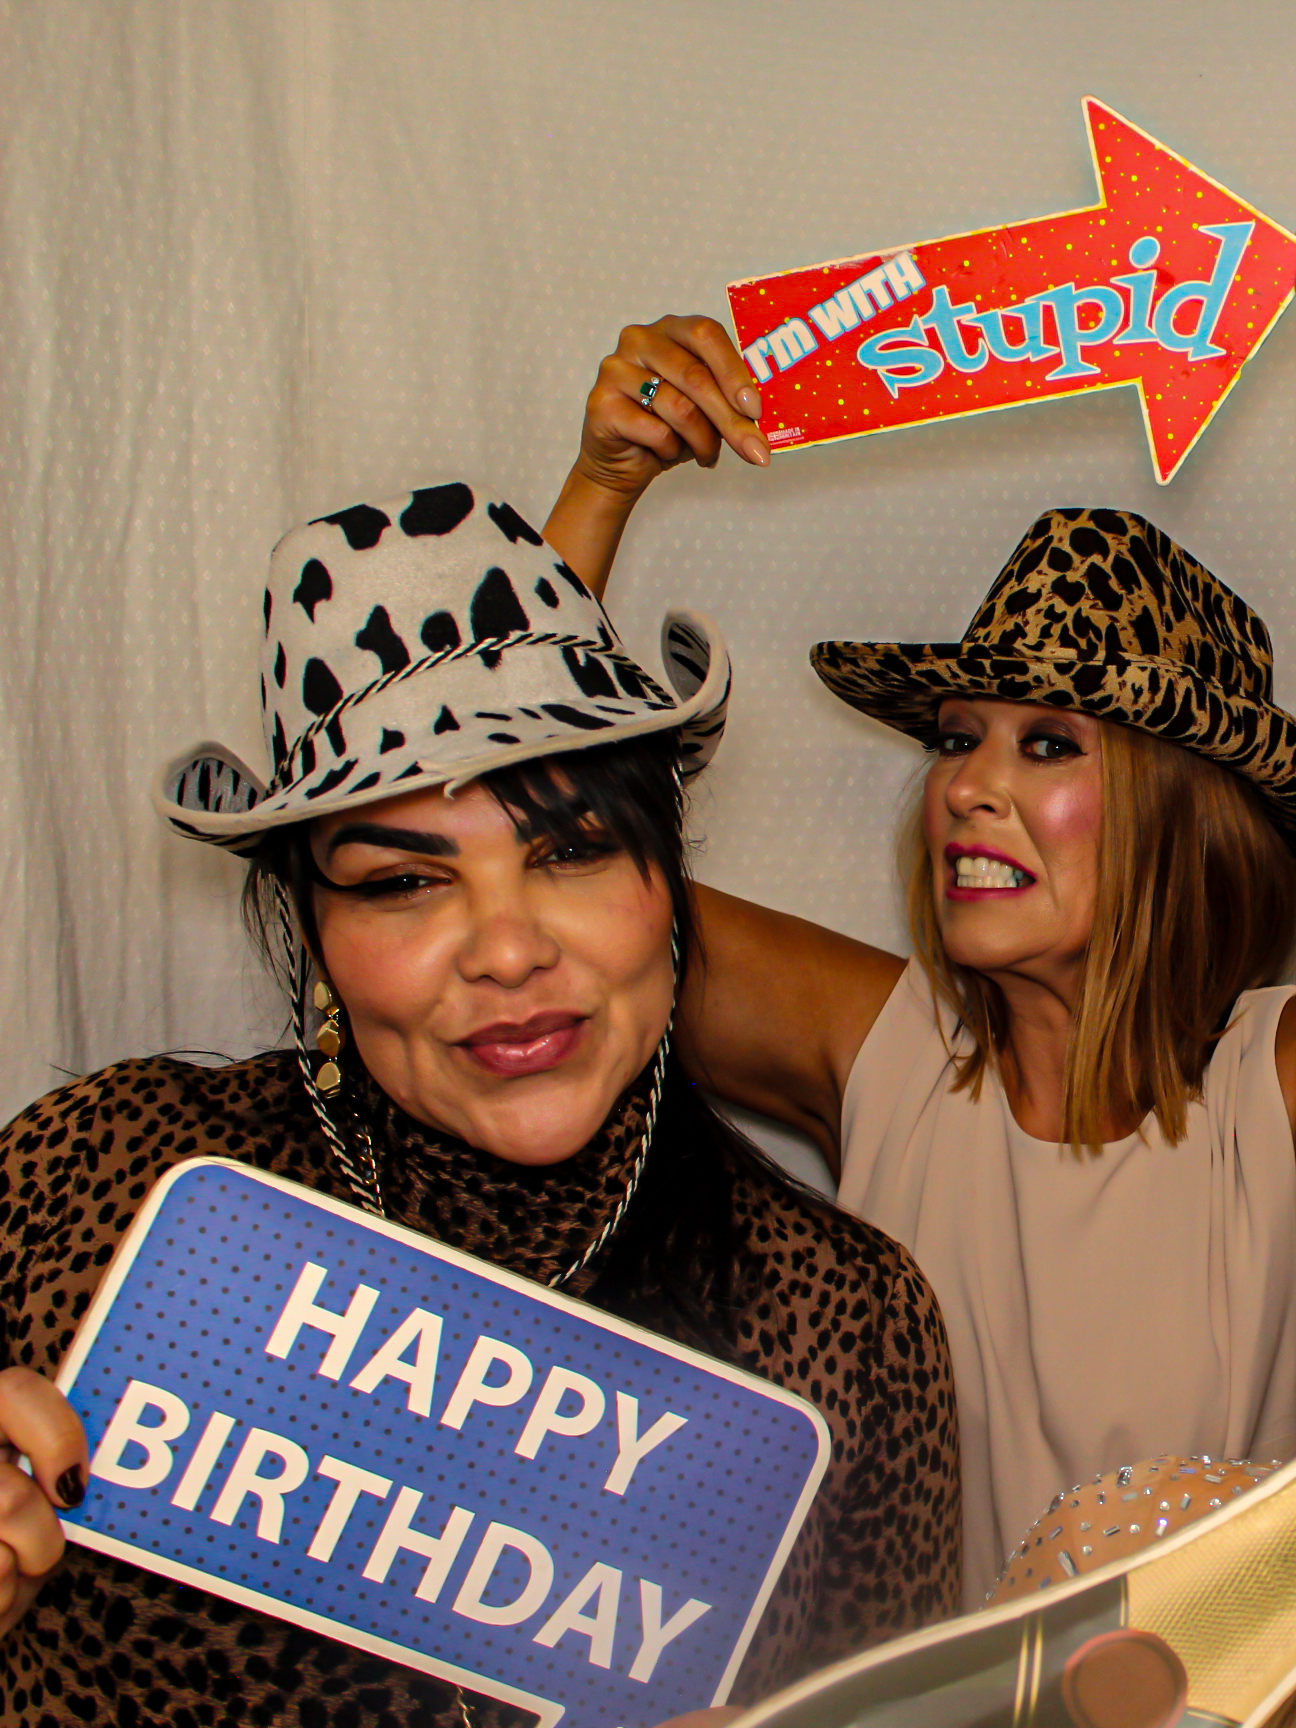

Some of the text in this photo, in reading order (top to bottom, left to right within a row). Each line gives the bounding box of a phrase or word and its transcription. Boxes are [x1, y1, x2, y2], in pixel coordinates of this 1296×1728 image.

[807, 251, 926, 342] WITH
[857, 221, 1256, 399] stupid
[264, 1261, 688, 1496] HAPPY
[89, 1380, 712, 1684] BIRTHDAY
